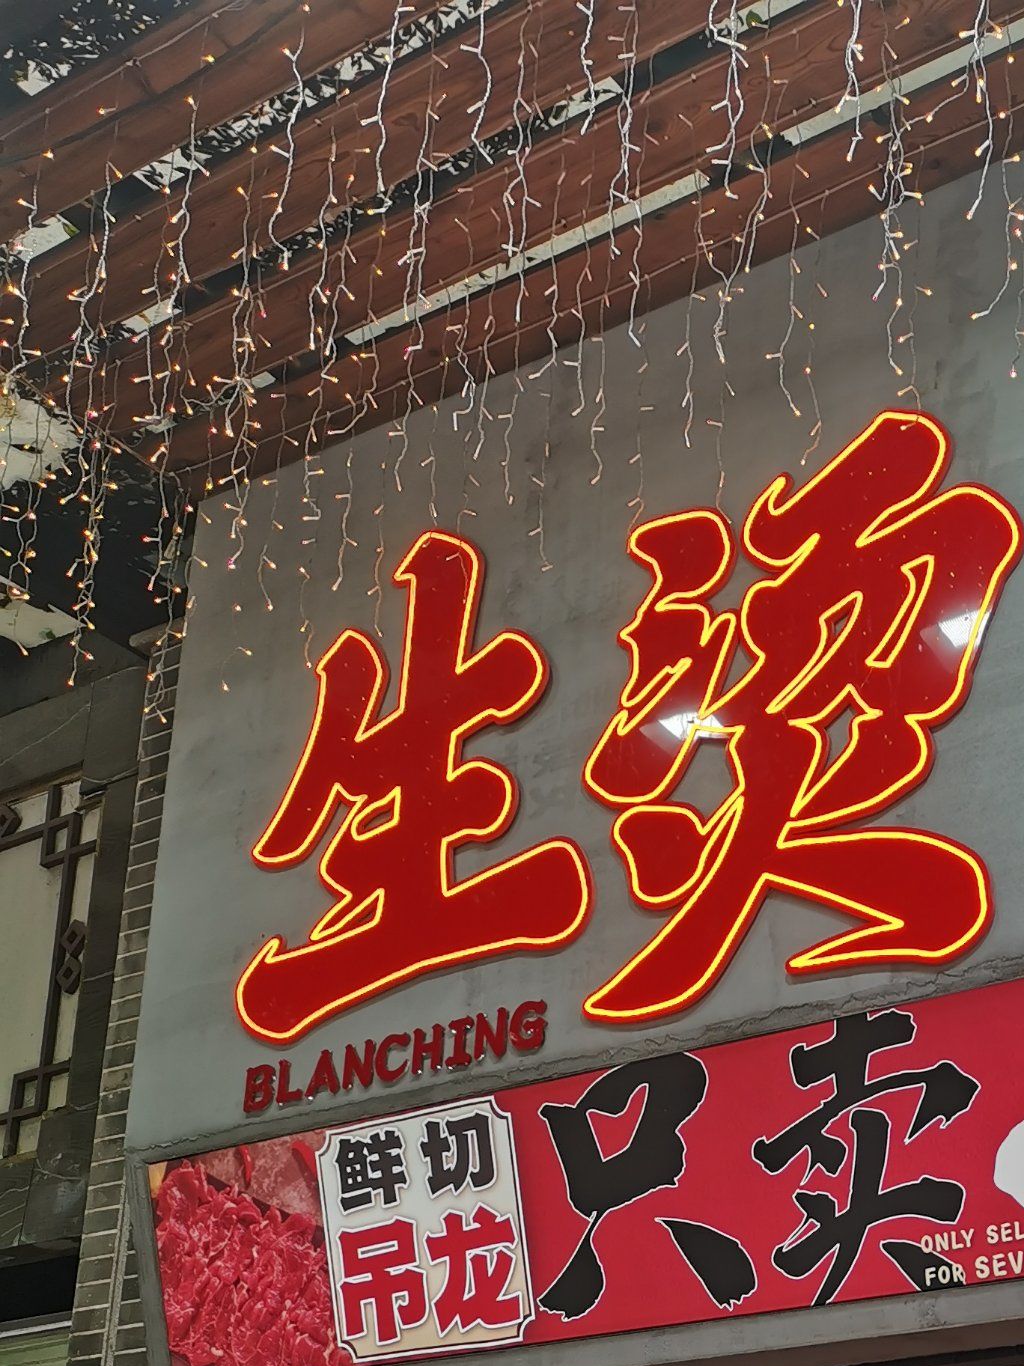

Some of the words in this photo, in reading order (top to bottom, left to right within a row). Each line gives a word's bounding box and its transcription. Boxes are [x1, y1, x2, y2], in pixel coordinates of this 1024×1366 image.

[236, 409, 1024, 1043] 生烫
[242, 1000, 548, 1113] BLANCHING
[332, 1107, 500, 1215] 鲜切
[337, 1205, 526, 1346] 吊龙
[920, 1228, 975, 1254] ONLY
[924, 1263, 965, 1287] FOR
